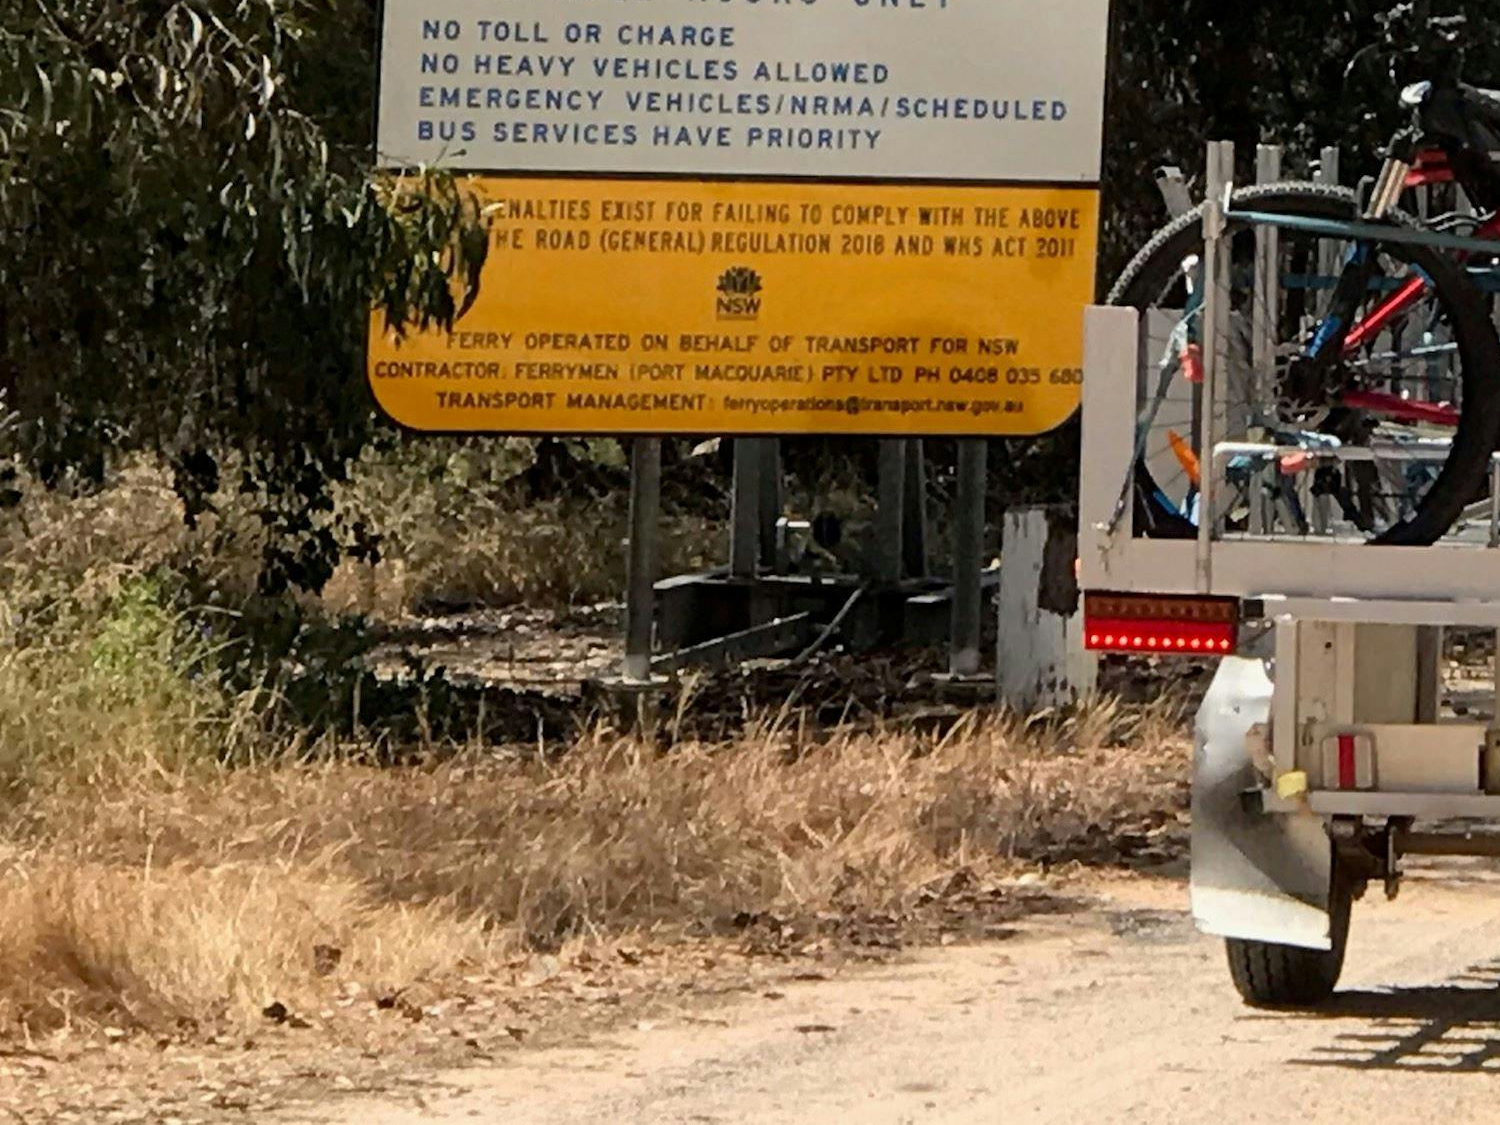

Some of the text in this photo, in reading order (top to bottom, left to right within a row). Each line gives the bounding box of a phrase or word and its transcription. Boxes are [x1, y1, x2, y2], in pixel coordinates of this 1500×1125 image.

[422, 20, 735, 48] NO TOLL OR CHARGE
[421, 54, 889, 85] NO HEAVY VEHICLES ALLOWED
[419, 87, 1068, 122] EMERGENCY VEHICLES/NRMA/SCHEDULED
[418, 121, 882, 150] BUS SERVICES HAVE PRIORITY
[483, 198, 1080, 230] ENALTIES EXIST FOR FAILING TO COMPLY WITH THE ABOVE
[487, 229, 524, 250] HE
[535, 228, 591, 250] ROAD
[600, 228, 705, 254] (GENERAL)
[711, 231, 831, 255] REGULATION
[894, 235, 934, 257] AND
[991, 236, 1026, 258] ACT
[1036, 237, 1075, 259] 2011
[716, 296, 761, 314] NSW
[447, 332, 1020, 356] FERRY OPERATED ON BEHALF OF TRANSPORT FOR NSW
[515, 362, 619, 381] FERRYMEN
[822, 365, 859, 383] PTY
[867, 365, 903, 384] LTD
[914, 366, 941, 384] PH
[1006, 367, 1041, 385] 035
[435, 391, 557, 410] TRANSPORT
